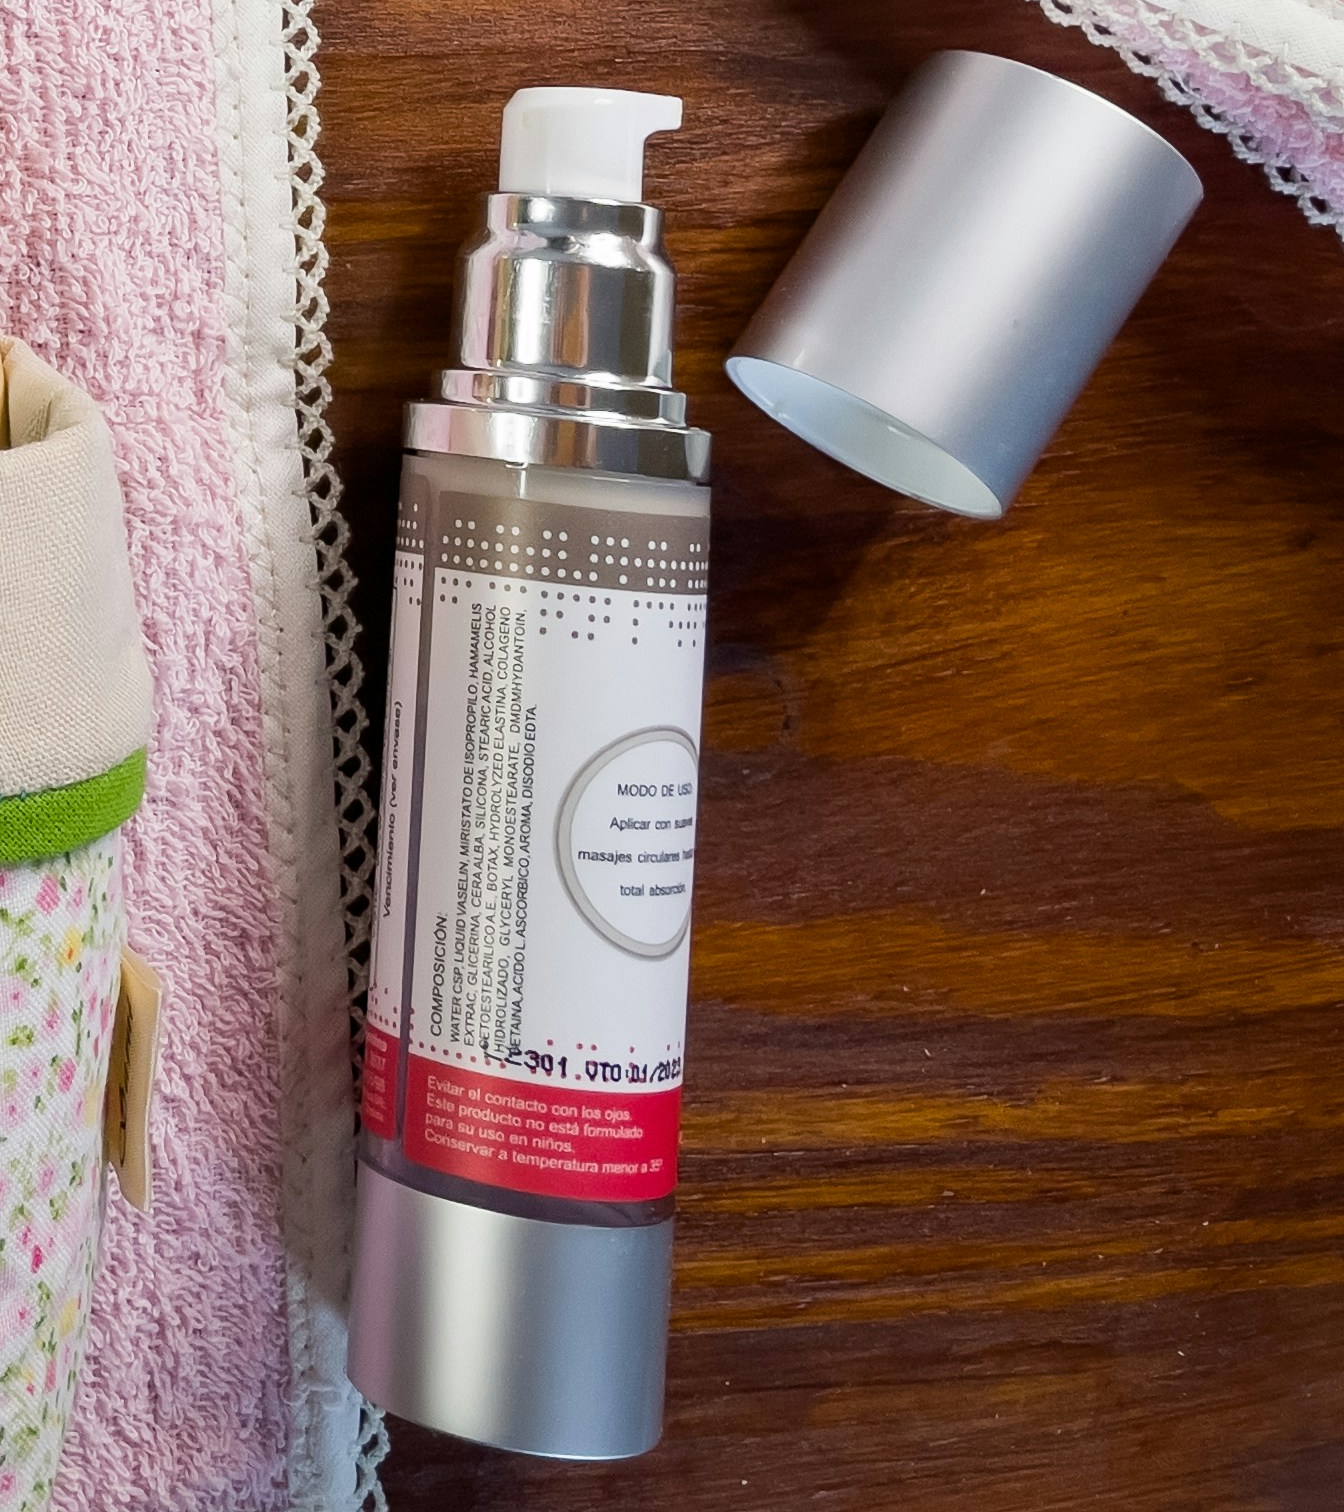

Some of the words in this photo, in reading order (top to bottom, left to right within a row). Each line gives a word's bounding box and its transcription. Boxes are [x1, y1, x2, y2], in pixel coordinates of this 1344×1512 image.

[469, 603, 482, 679] HAMAMELIS
[484, 605, 496, 667] ALCOHOL
[464, 682, 479, 764] ISOPROPILO,
[479, 704, 491, 762] STEARIC
[489, 753, 503, 841] HYDROLYZED
[497, 607, 510, 680] COLAGENO
[463, 767, 473, 785] DE
[475, 766, 488, 829] SILICONA,
[617, 784, 657, 797] MODO
[661, 784, 675, 797] DE
[460, 787, 472, 856] MIRISTATO
[610, 817, 651, 831] Aplicar
[655, 820, 671, 830] con
[512, 952, 524, 995] ACIDO
[522, 744, 535, 798] DISODIO
[578, 850, 632, 865] masajes
[471, 873, 482, 907] CERA
[500, 876, 513, 946] GLYCERYL
[620, 884, 644, 896] total
[454, 919, 465, 963] LIQUID
[450, 997, 462, 1043] WATER
[427, 1075, 465, 1096] Evitar
[468, 1089, 480, 1101] el
[485, 1093, 547, 1113] contacto
[552, 1105, 577, 1117] con
[582, 1105, 601, 1119] los
[427, 1092, 455, 1112] Este
[459, 1105, 521, 1126] producto
[526, 1119, 545, 1130] no
[549, 1122, 579, 1135] está
[583, 1123, 643, 1138] formulado
[425, 1128, 494, 1157] Conservar
[498, 1149, 508, 1160] a
[512, 1150, 598, 1173] temperatura
[602, 1163, 638, 1174] menor
[641, 1163, 648, 1174] a
[426, 1113, 453, 1129] para
[458, 1123, 475, 1135] su
[479, 1128, 505, 1141] uso
[510, 1134, 528, 1146] en
